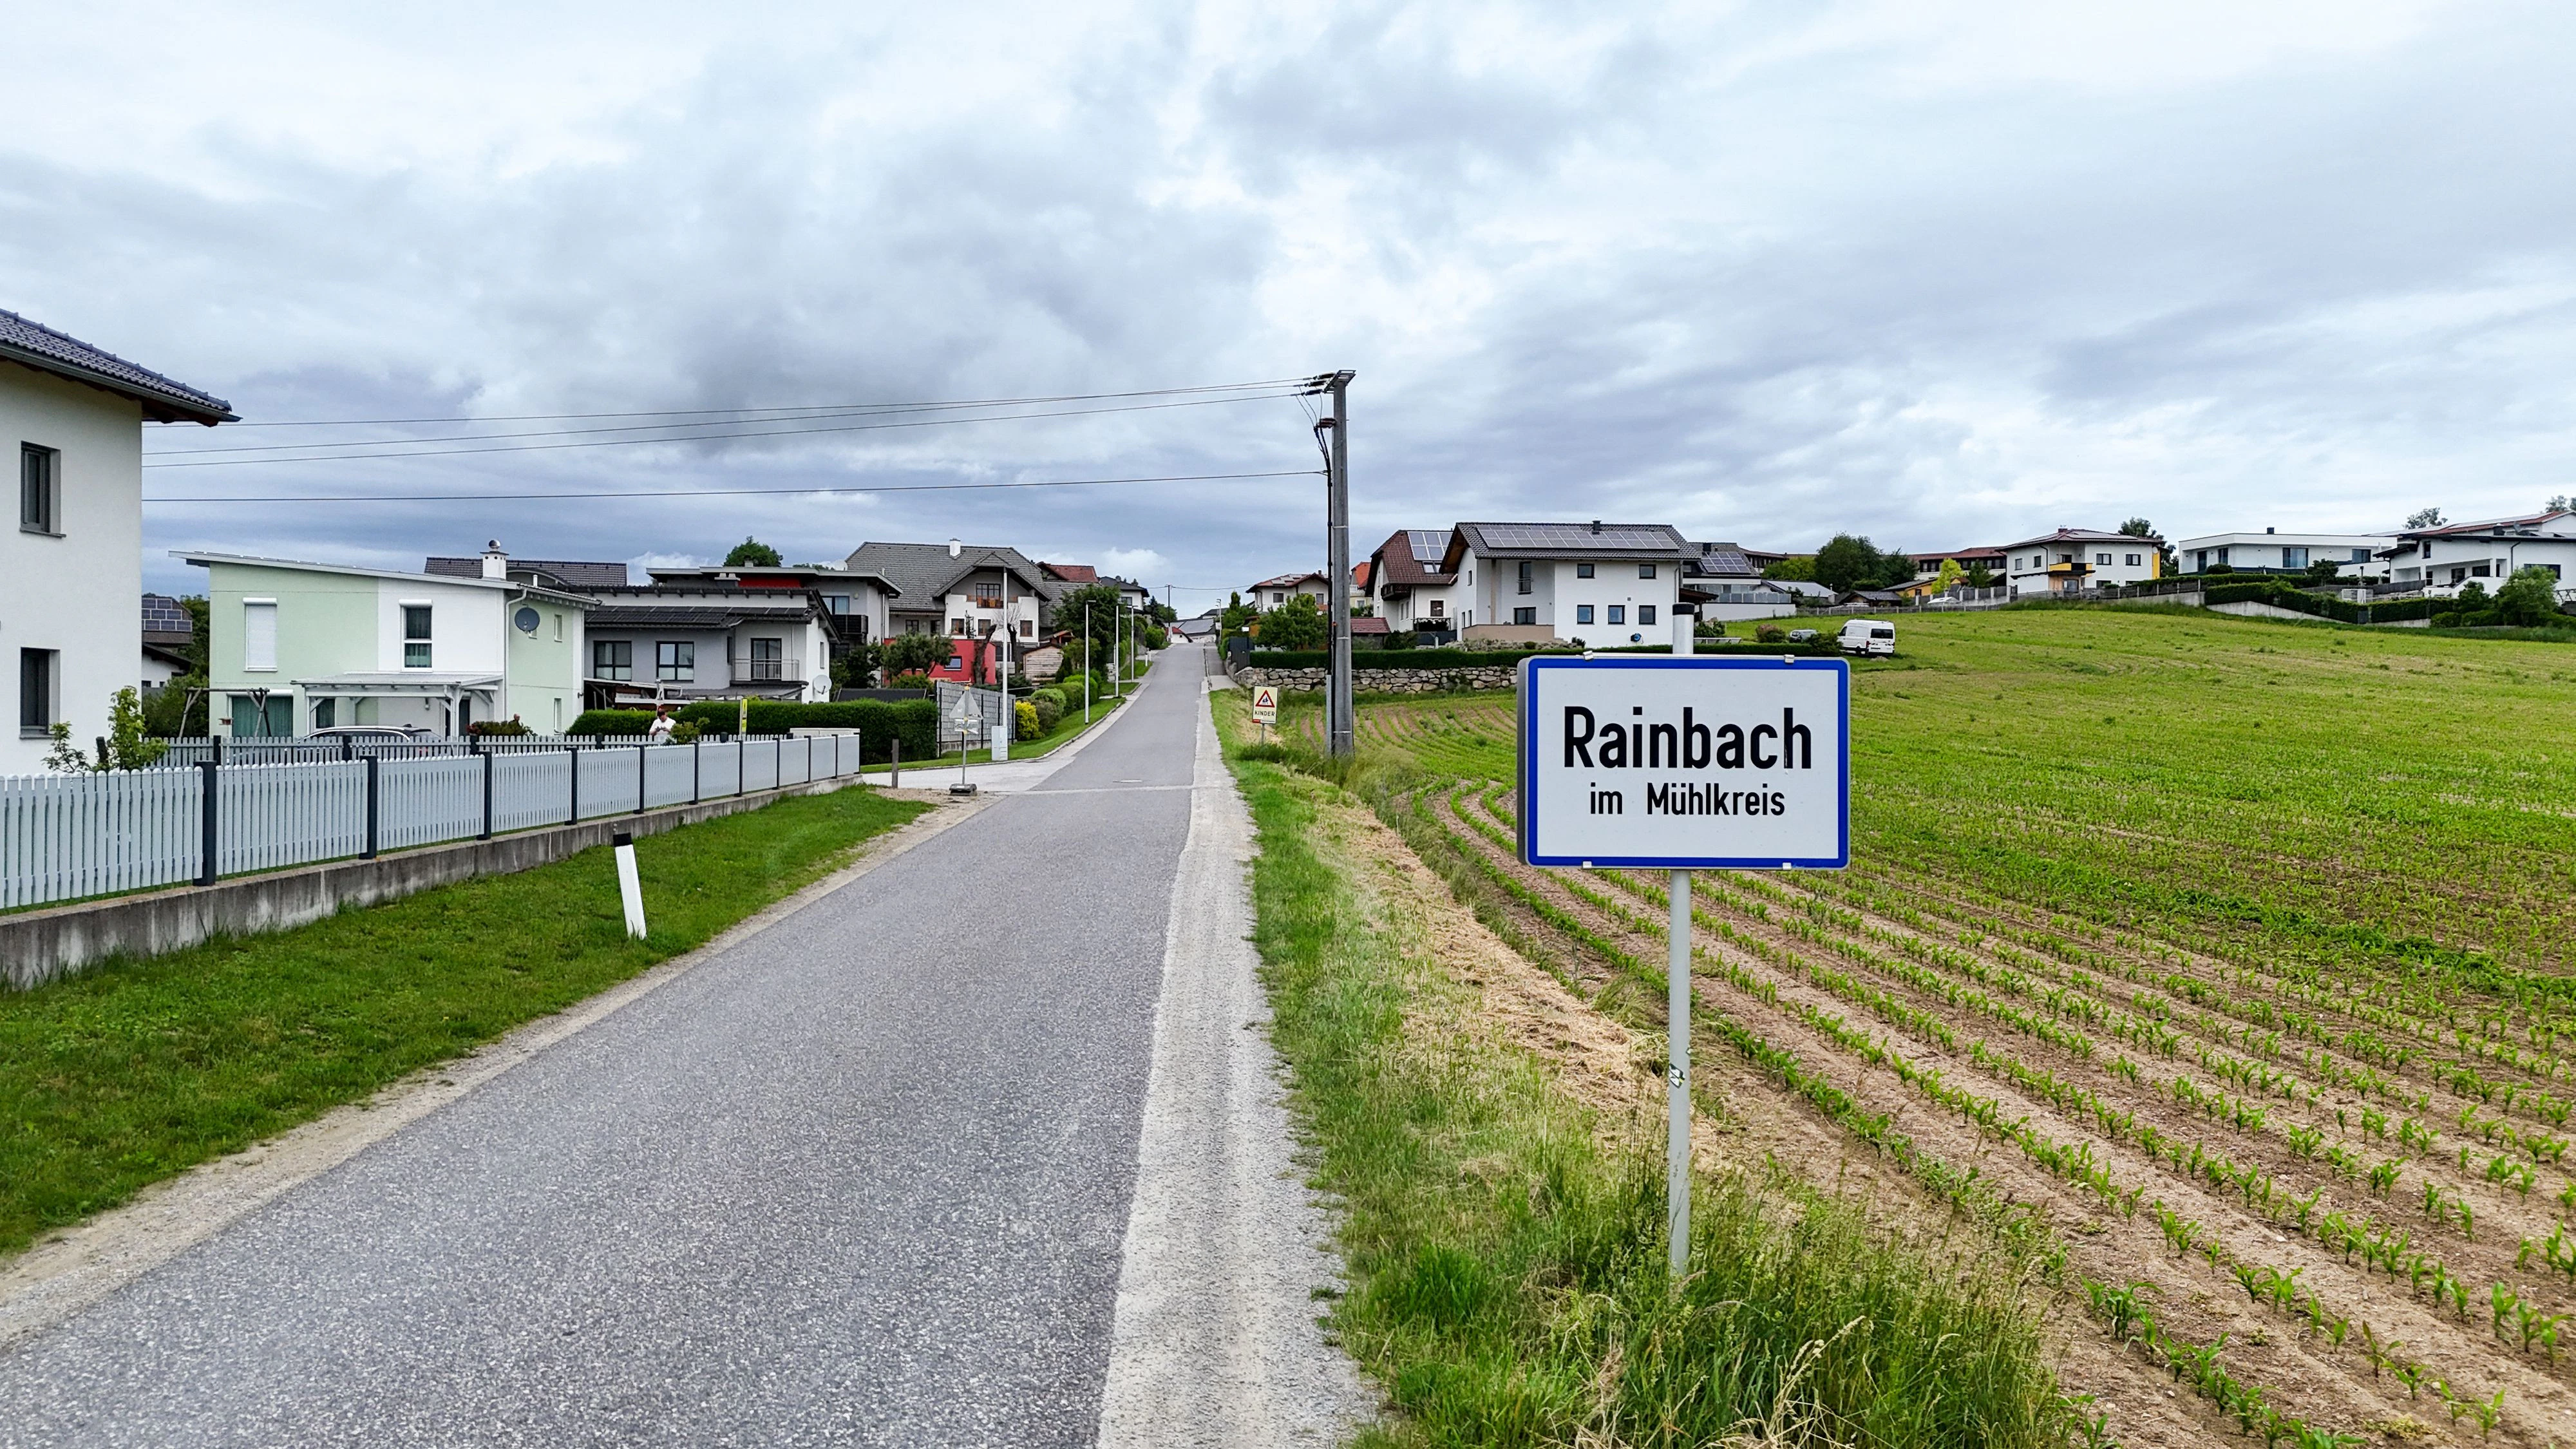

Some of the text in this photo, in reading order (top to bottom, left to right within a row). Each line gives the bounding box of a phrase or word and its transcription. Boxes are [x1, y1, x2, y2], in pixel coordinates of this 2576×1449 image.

[1564, 706, 1812, 770] Rainbach
[1590, 782, 1785, 816] im Mühlkreis
